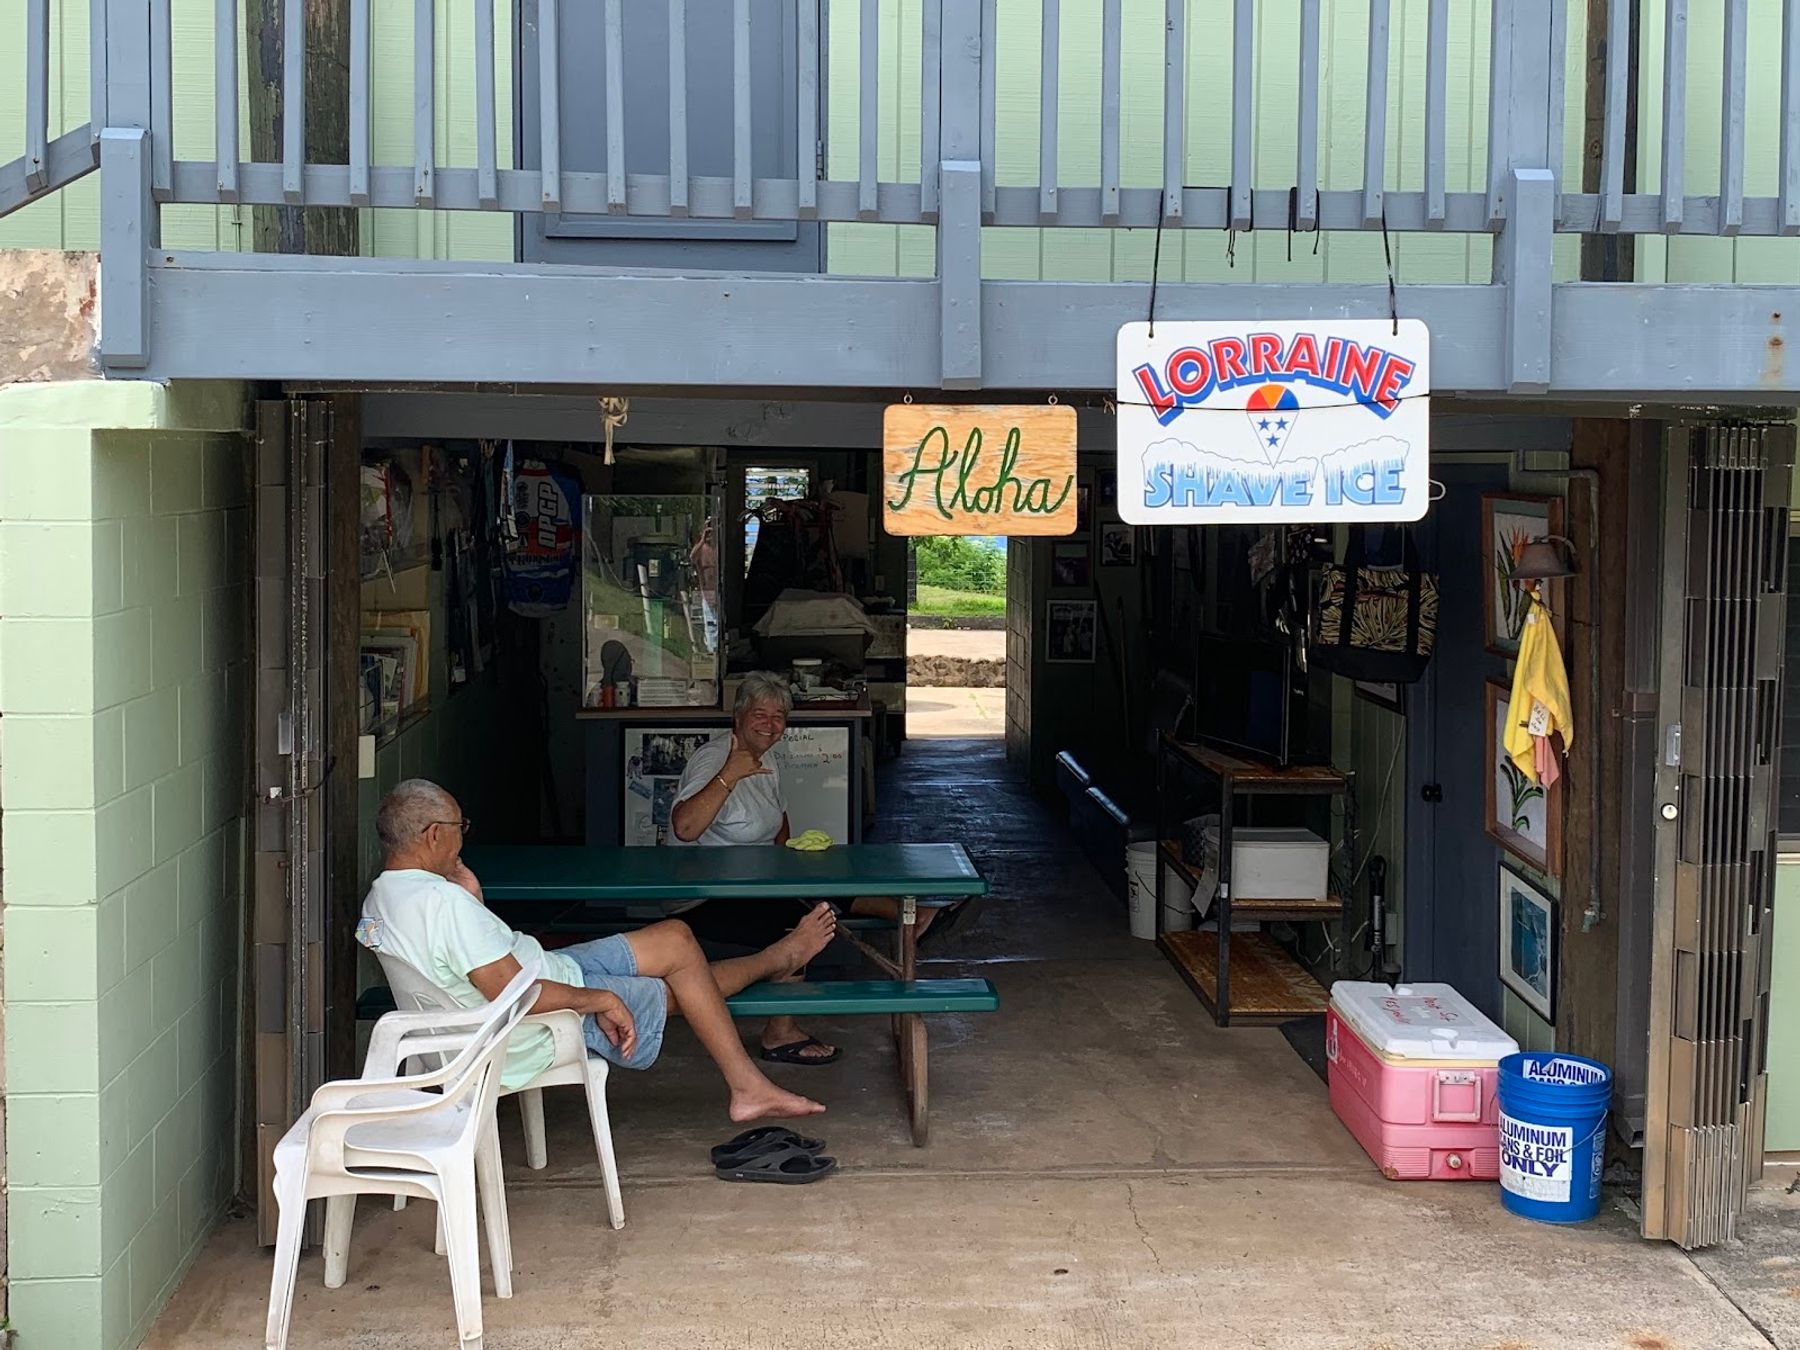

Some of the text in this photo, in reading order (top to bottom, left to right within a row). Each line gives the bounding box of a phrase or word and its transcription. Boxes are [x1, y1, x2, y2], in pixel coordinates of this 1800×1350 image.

[1133, 332, 1415, 428] LORRAINE
[889, 426, 1075, 519] Aloha
[1143, 457, 1408, 508] SHAVE ICE
[1529, 1060, 1603, 1084] ALUMINUM
[1501, 1150, 1560, 1178] ONLY
[1523, 1144, 1533, 1160] &
[1536, 1147, 1567, 1164] FOIL
